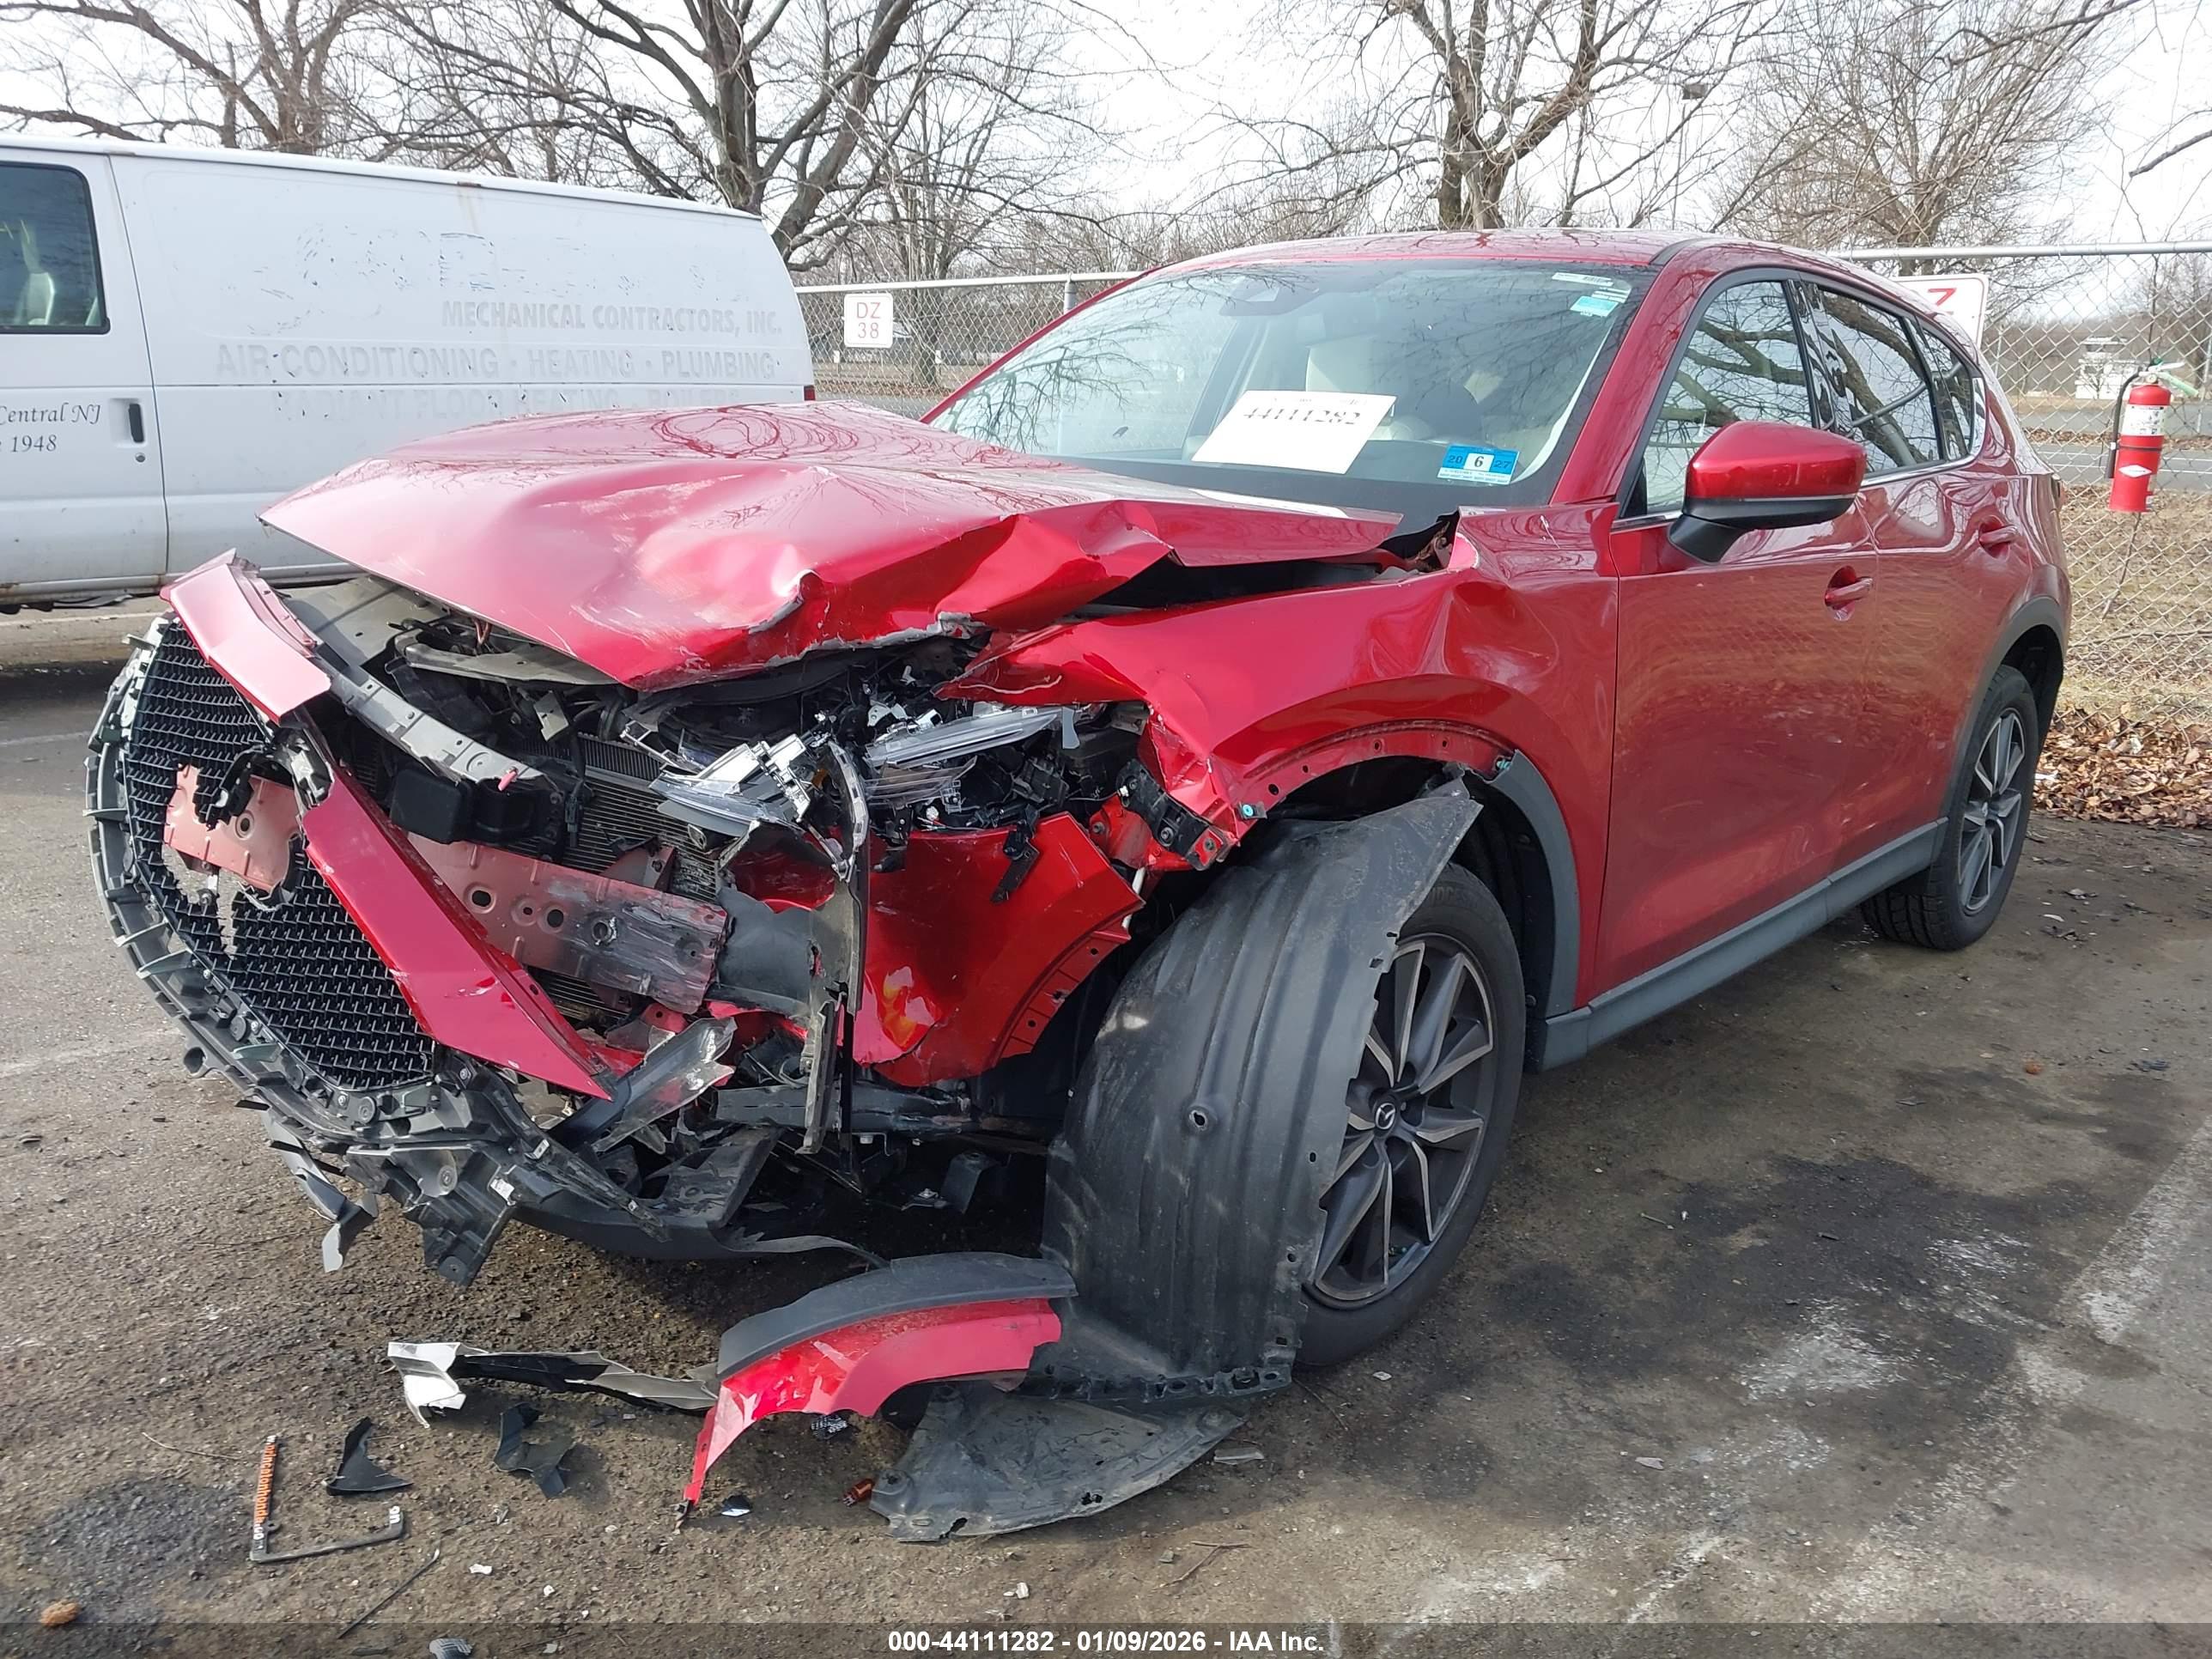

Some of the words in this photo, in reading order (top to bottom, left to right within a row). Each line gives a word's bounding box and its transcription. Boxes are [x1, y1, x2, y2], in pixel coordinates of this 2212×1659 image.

[441, 301, 586, 329] MECHANICAL
[592, 305, 740, 337] CONTRACTORS,
[746, 311, 782, 334] INC.
[856, 301, 881, 319] DZ
[858, 322, 879, 339] 38
[216, 344, 271, 377] AIR
[280, 344, 500, 379] CONDITIONING
[527, 349, 635, 379] HEATING
[661, 350, 775, 379] PLUMBING
[71, 404, 101, 425] NJ
[1243, 408, 1361, 425] 44111282
[10, 434, 58, 453] 1948
[1474, 455, 1485, 468] 6
